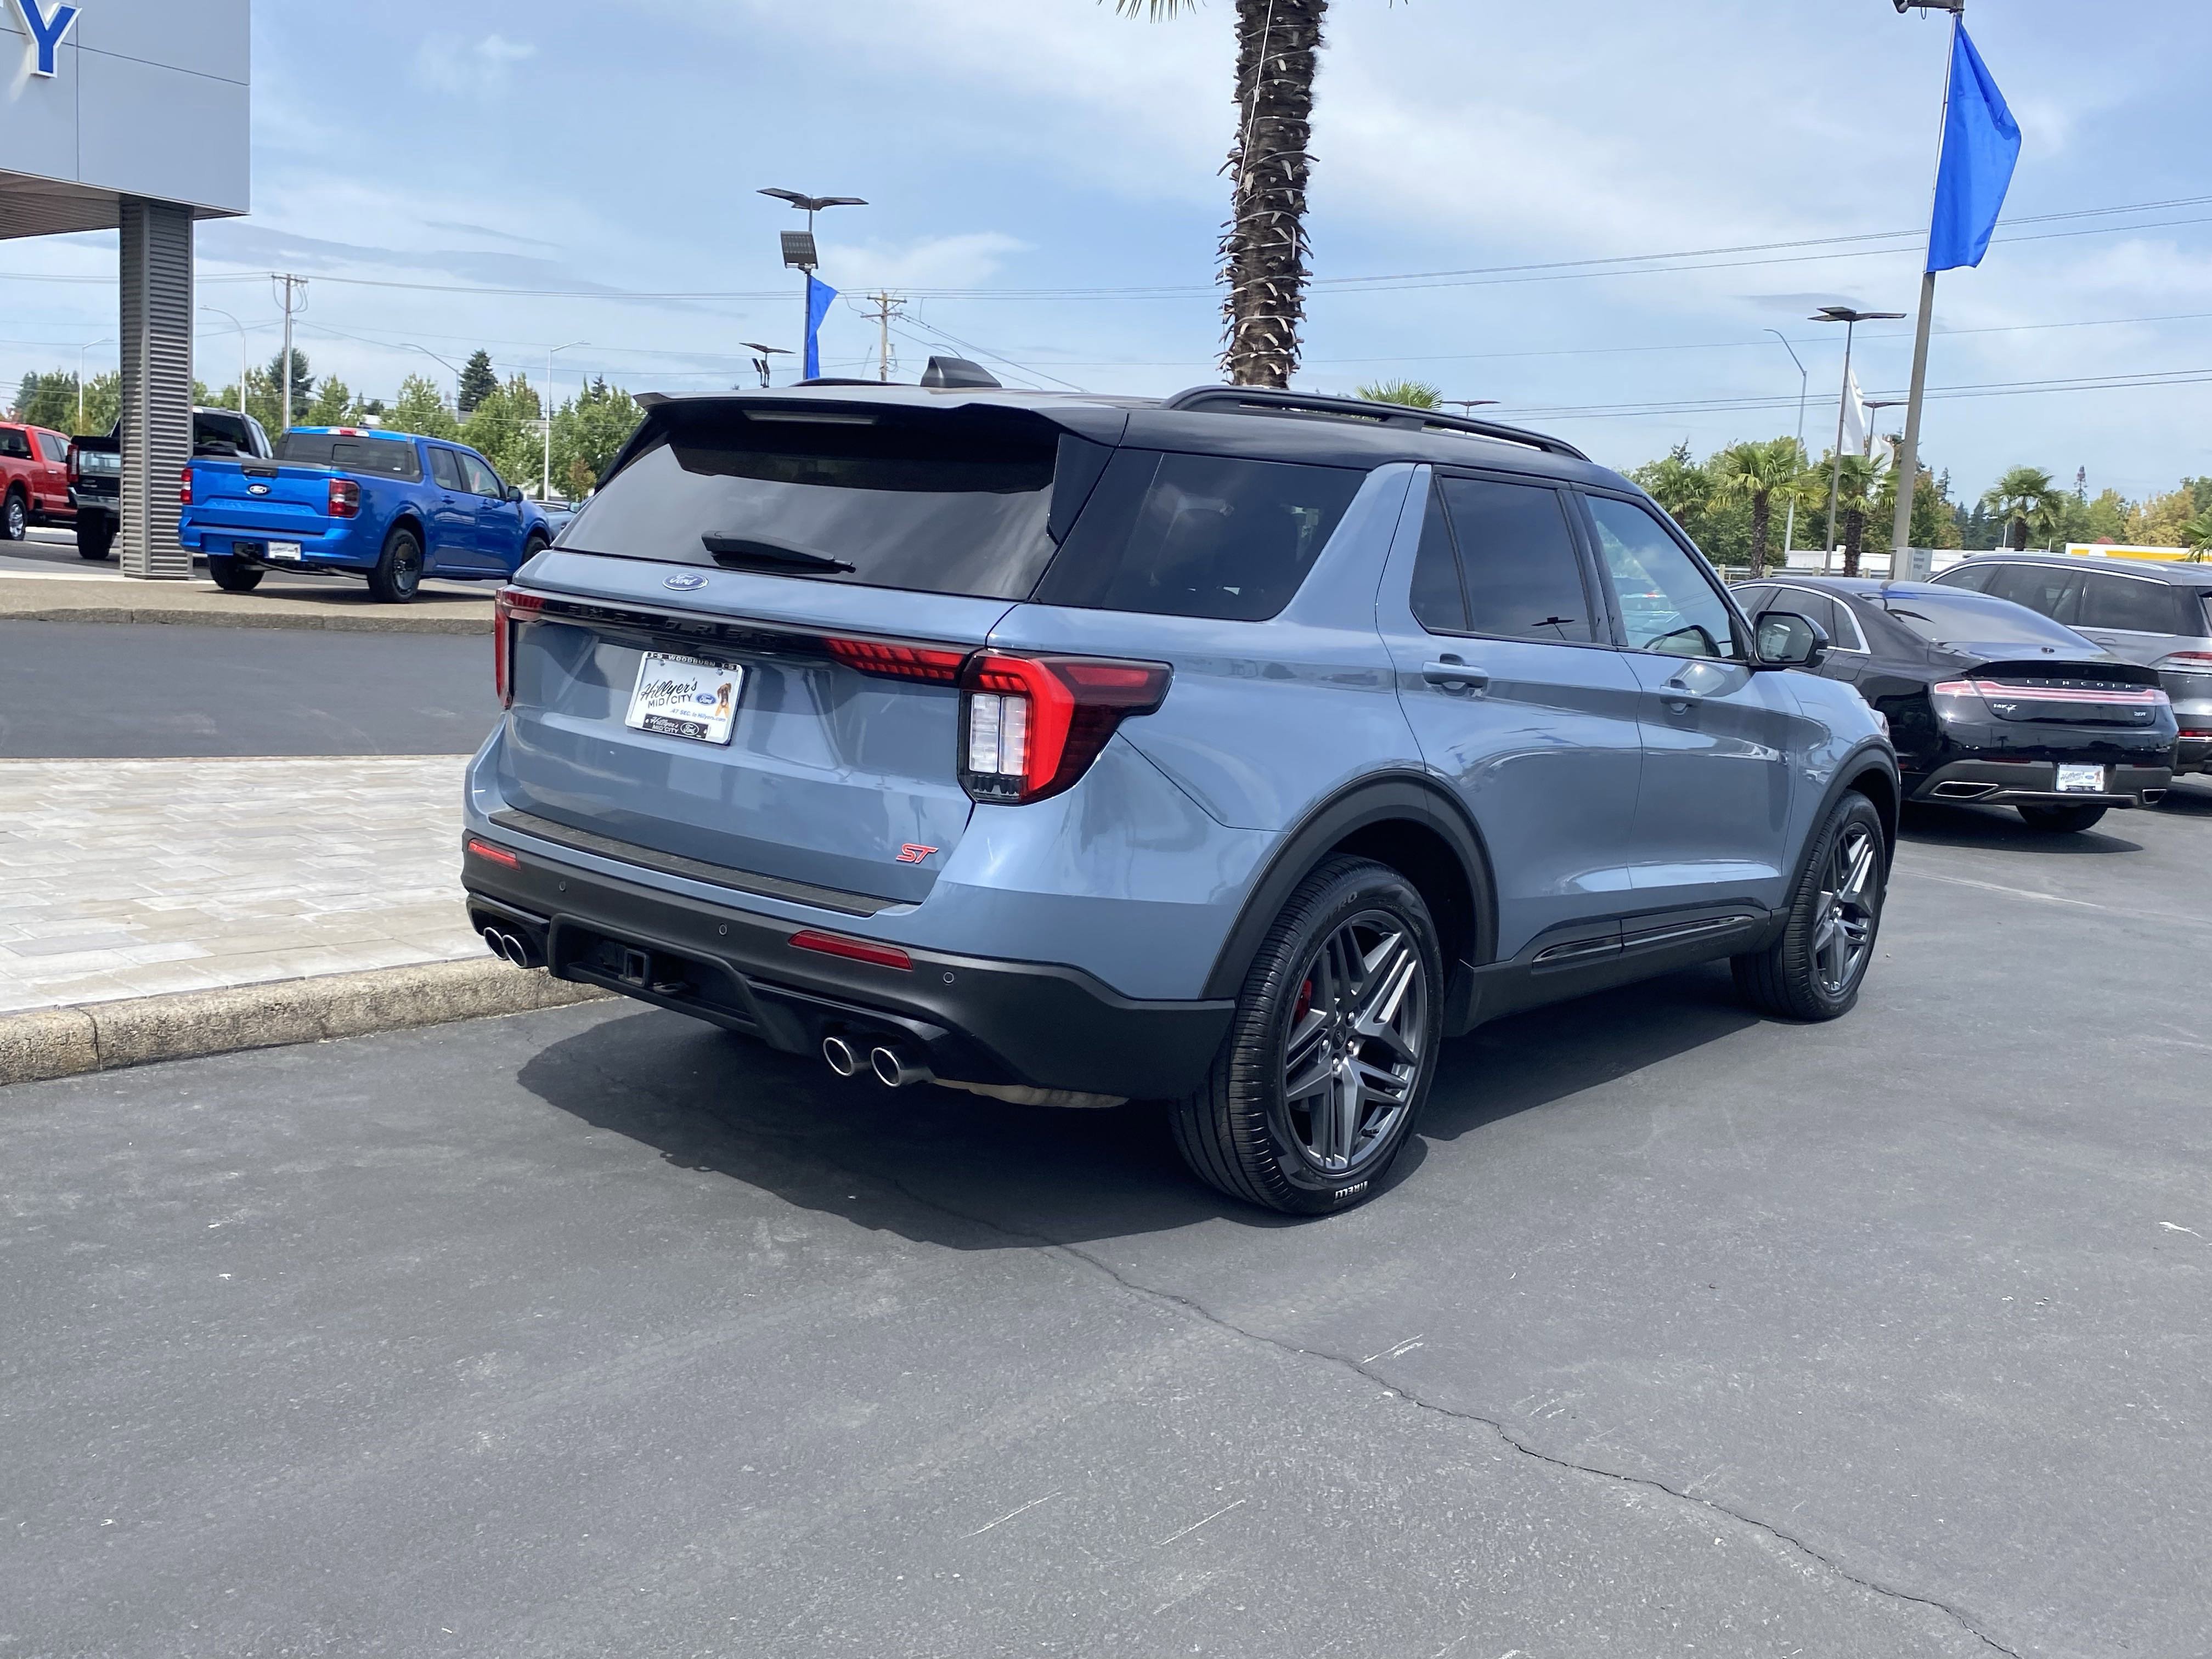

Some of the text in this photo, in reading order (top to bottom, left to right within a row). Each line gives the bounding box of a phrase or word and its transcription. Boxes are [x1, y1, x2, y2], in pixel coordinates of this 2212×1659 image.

[669, 574, 698, 585] Ford
[668, 654, 715, 667] WOODBURN
[640, 677, 698, 705] Hillyer's
[648, 693, 713, 708] MID CITY Ford
[895, 843, 939, 864] ST
[1335, 1181, 1368, 1199] PIRELLI
